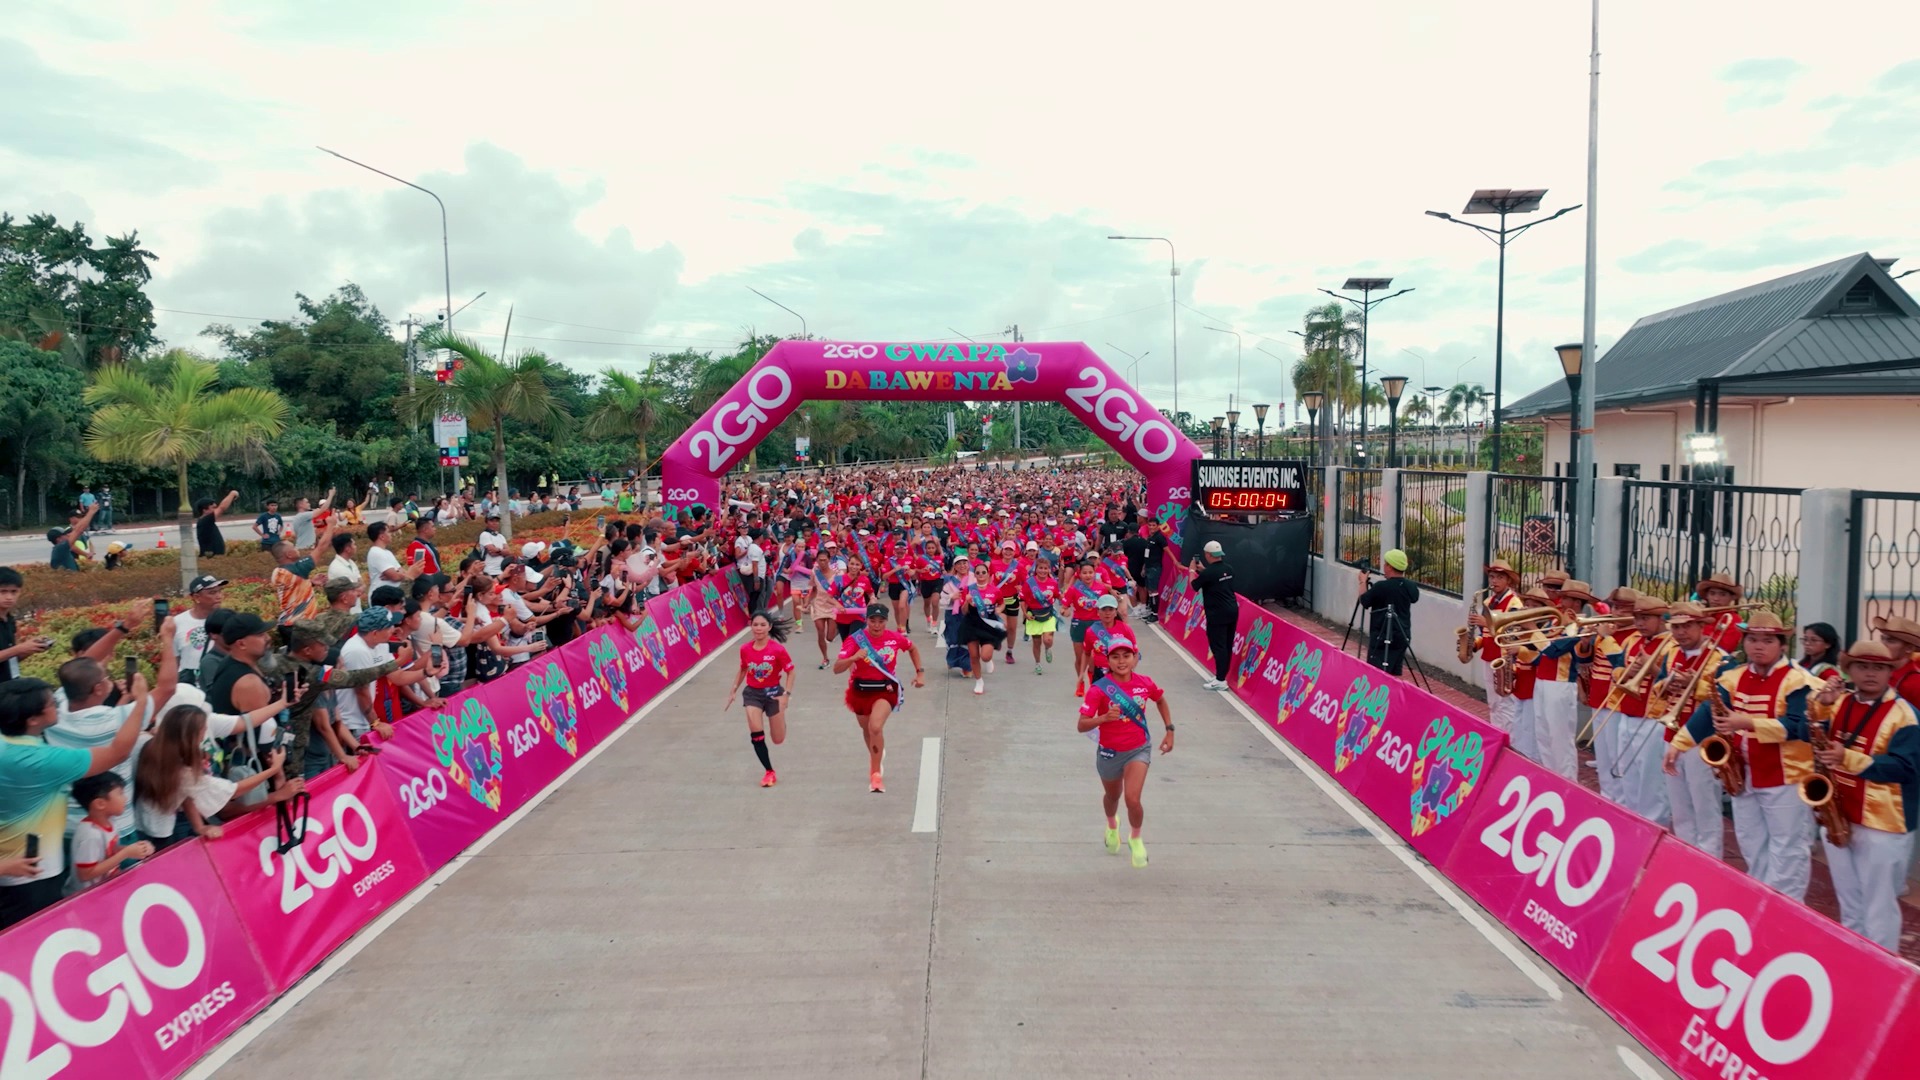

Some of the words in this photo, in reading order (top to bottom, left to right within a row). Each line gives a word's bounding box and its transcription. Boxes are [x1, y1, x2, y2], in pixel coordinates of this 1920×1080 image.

[822, 344, 878, 359] 2GO
[884, 344, 1007, 361] GWAPA
[825, 370, 1014, 391] DABAWENYA
[689, 365, 792, 472] 2GO
[1065, 366, 1177, 463] 2GO
[667, 488, 699, 501] 2GO
[1168, 486, 1191, 499] 2G
[1199, 466, 1240, 488] SUNRISE
[1241, 467, 1279, 488] EVENTS
[1280, 467, 1300, 488] INC.
[1211, 492, 1287, 507] 05:00:04
[624, 646, 645, 673] 2GO
[1262, 656, 1285, 685] 2GO
[577, 677, 601, 710] 2GO
[1309, 690, 1339, 724] 2GO
[431, 698, 498, 767] GWAPA
[506, 717, 541, 759] 2GO
[1375, 730, 1413, 774] 2GO
[1416, 715, 1485, 787] GWAPA
[399, 767, 448, 819] 2GO
[258, 793, 378, 915] 2GO
[1480, 775, 1616, 907] 2GO
[352, 859, 396, 898] EXPRESS
[1522, 898, 1578, 950] EXPRESS
[0, 883, 206, 1080] 2GO
[1630, 882, 1834, 1065] 2GO
[155, 980, 237, 1052] EXPRESS
